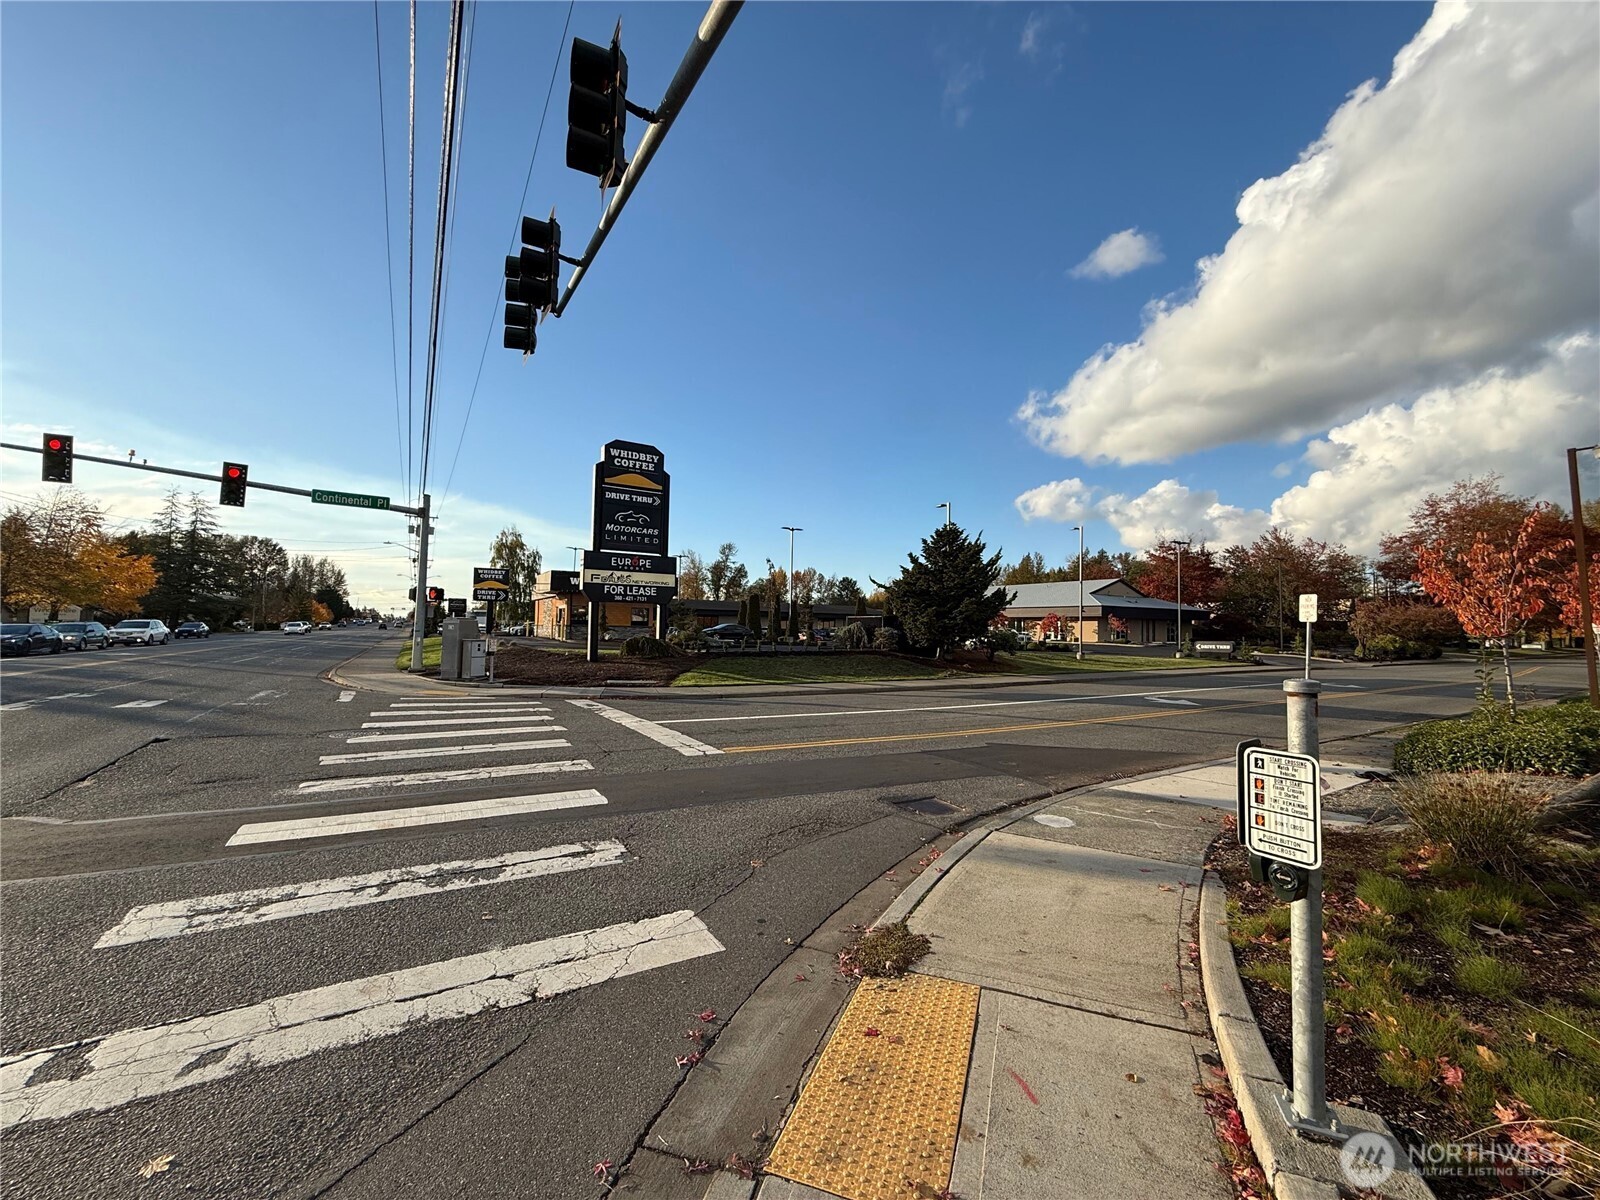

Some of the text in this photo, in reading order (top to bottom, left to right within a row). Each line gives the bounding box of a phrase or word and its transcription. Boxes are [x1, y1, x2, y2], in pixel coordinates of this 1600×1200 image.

[609, 447, 659, 463] WHIDBEY
[614, 458, 655, 471] COFFEE
[315, 491, 387, 508] Continental Pl
[605, 491, 653, 504] DRIVE THRU
[605, 523, 659, 536] MOTORCARS
[605, 534, 659, 544] LIMITED
[611, 556, 652, 569] EUROPE
[604, 585, 657, 596] FOR LEASE
[1284, 758, 1307, 768] CROSSING
[1282, 800, 1309, 811] REMAINING
[1290, 823, 1305, 832] CROSS
[1262, 833, 1302, 848] PUSH BUTTON
[1276, 846, 1296, 857] CROSS
